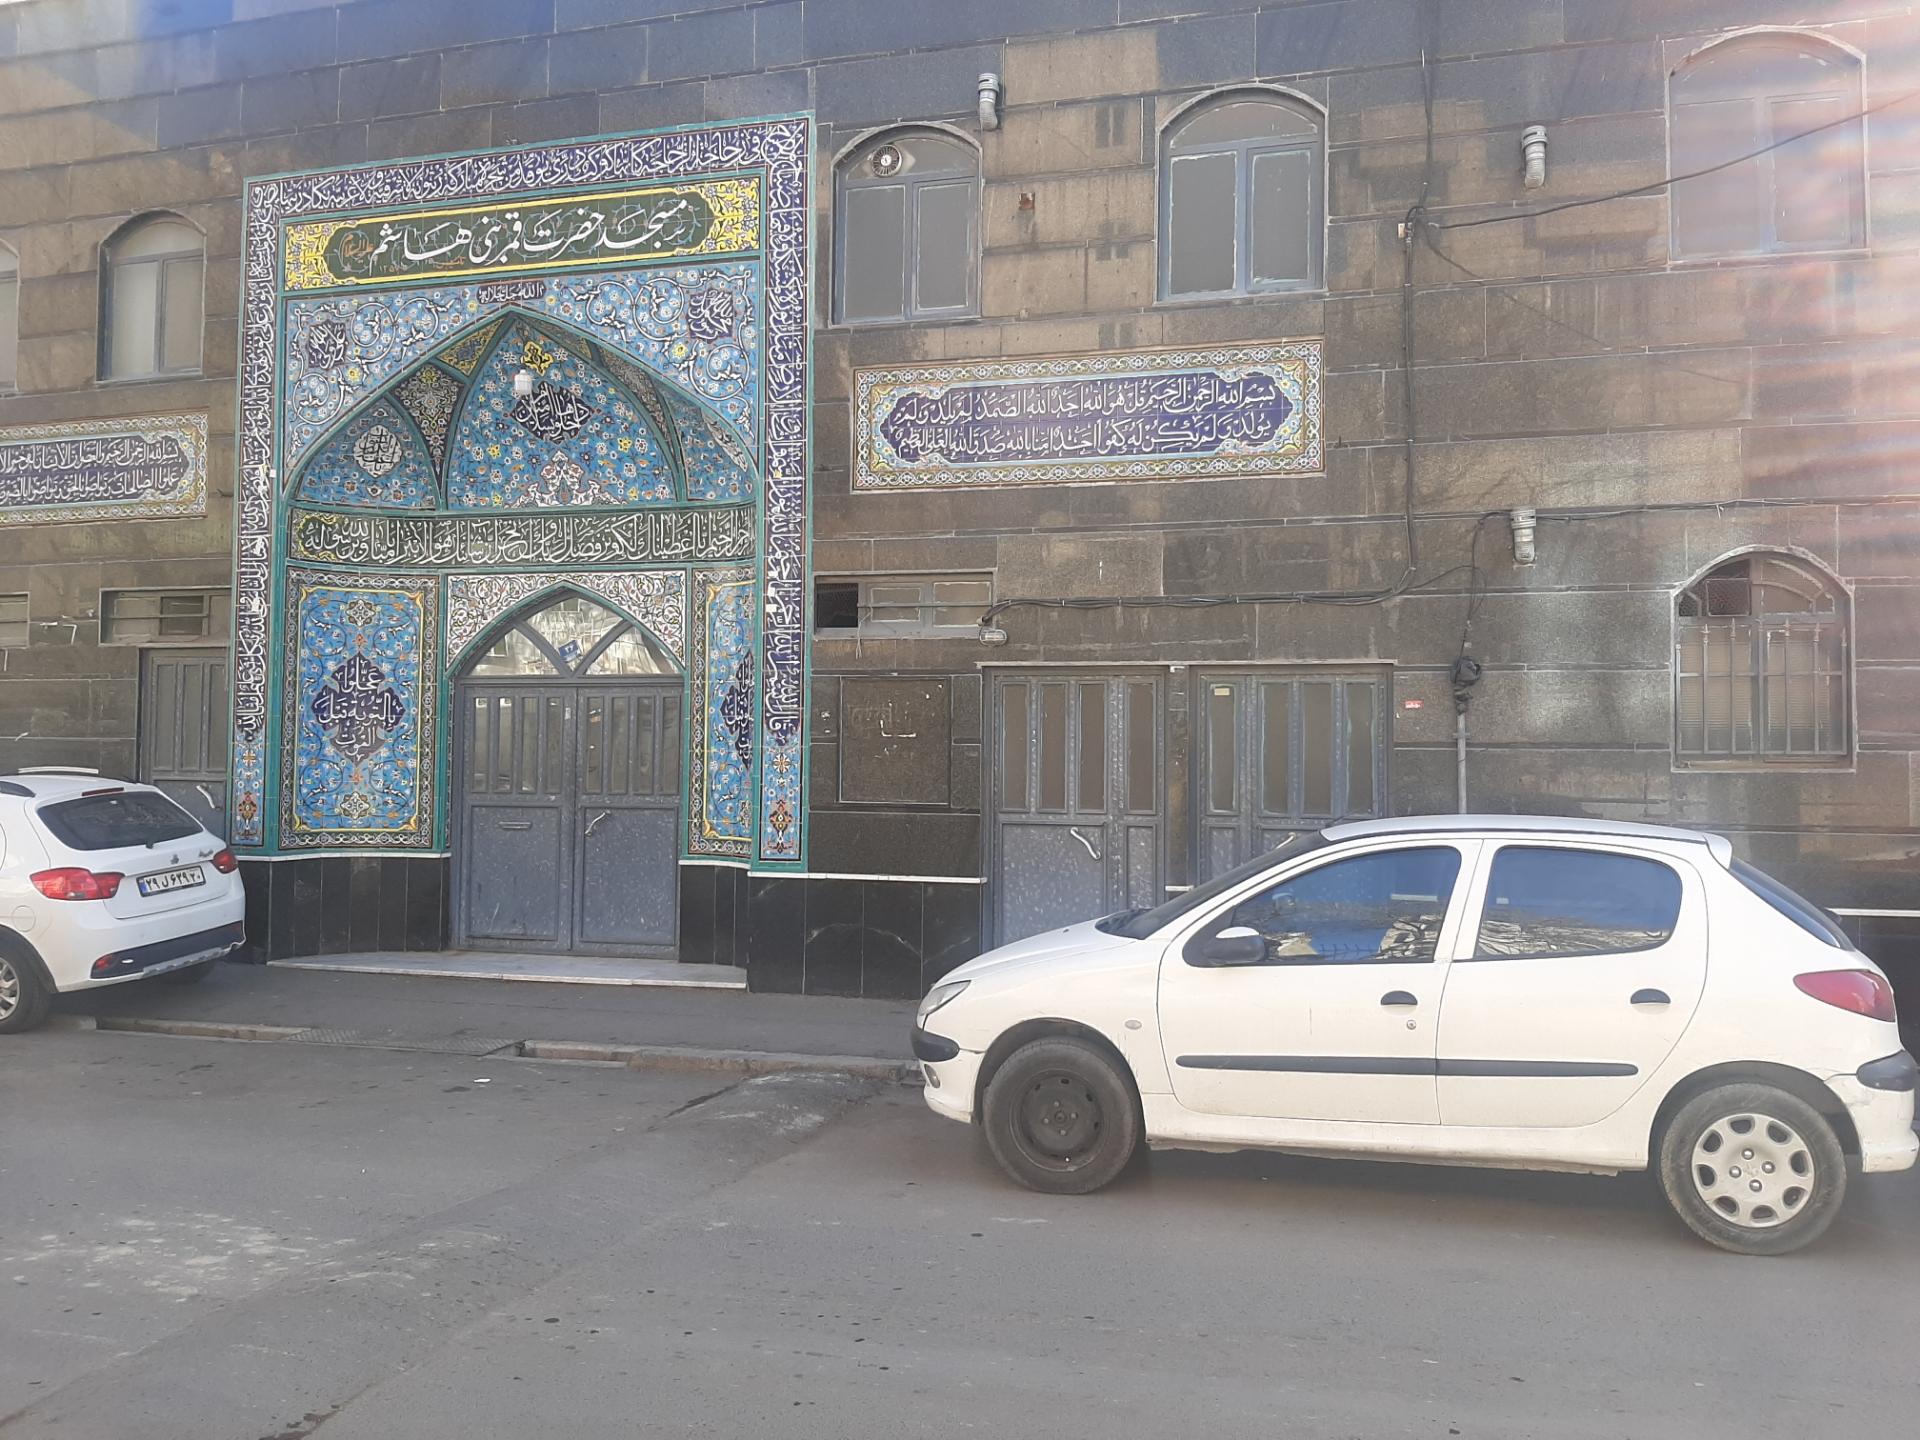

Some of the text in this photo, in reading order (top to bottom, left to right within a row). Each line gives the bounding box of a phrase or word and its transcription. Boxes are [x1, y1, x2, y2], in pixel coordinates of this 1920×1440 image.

[368, 221, 474, 276] هاشم
[485, 211, 525, 266] قمر
[523, 208, 607, 261] حضرت
[597, 199, 689, 251] مسجد
